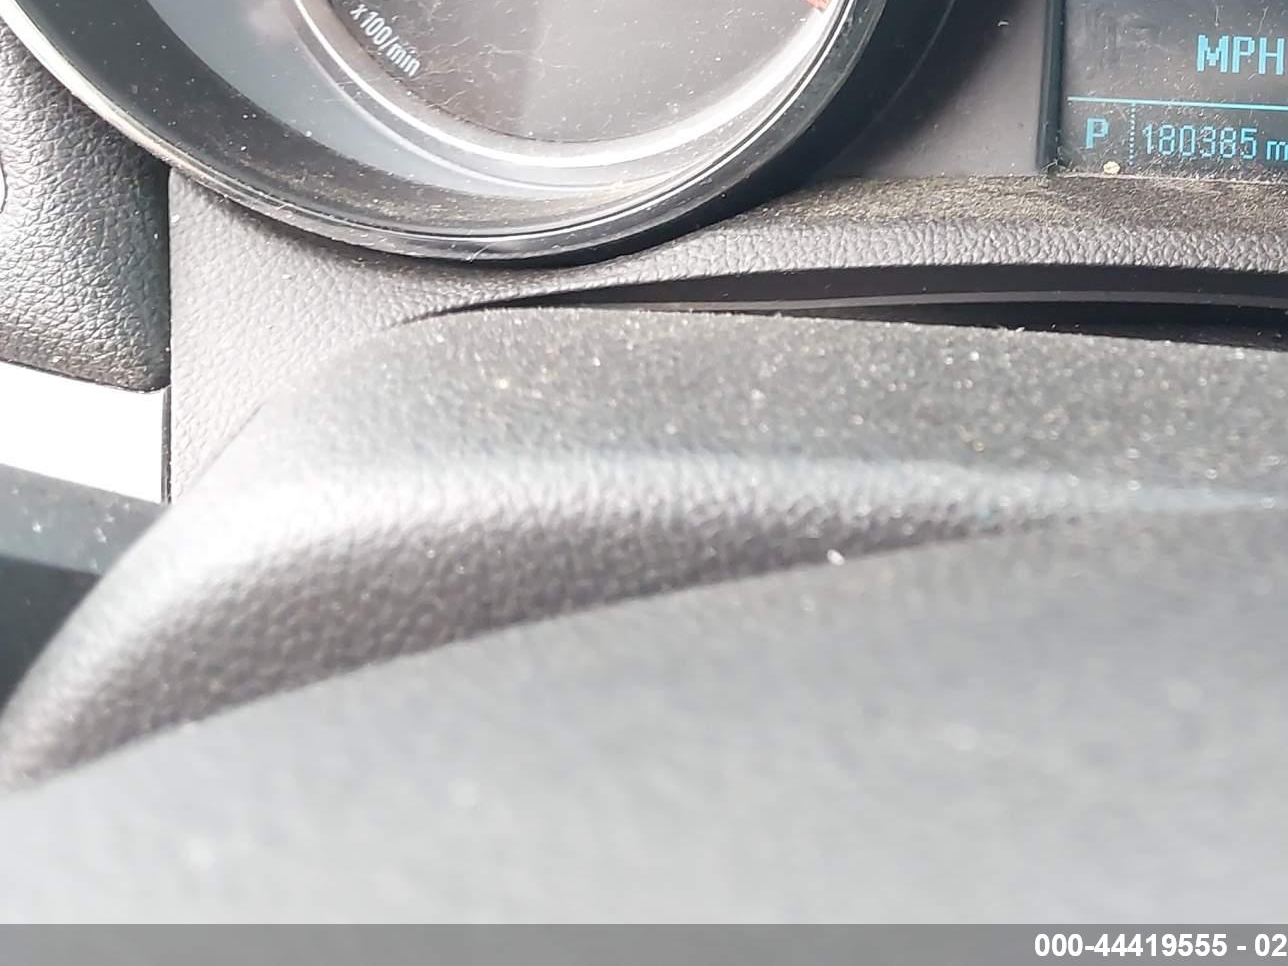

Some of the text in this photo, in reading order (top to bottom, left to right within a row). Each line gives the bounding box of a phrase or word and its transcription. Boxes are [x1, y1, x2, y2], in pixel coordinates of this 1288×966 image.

[350, 3, 422, 75] x100/min
[1196, 34, 1286, 75] MPH
[1085, 117, 1110, 149] P
[1142, 123, 1258, 160] 180385
